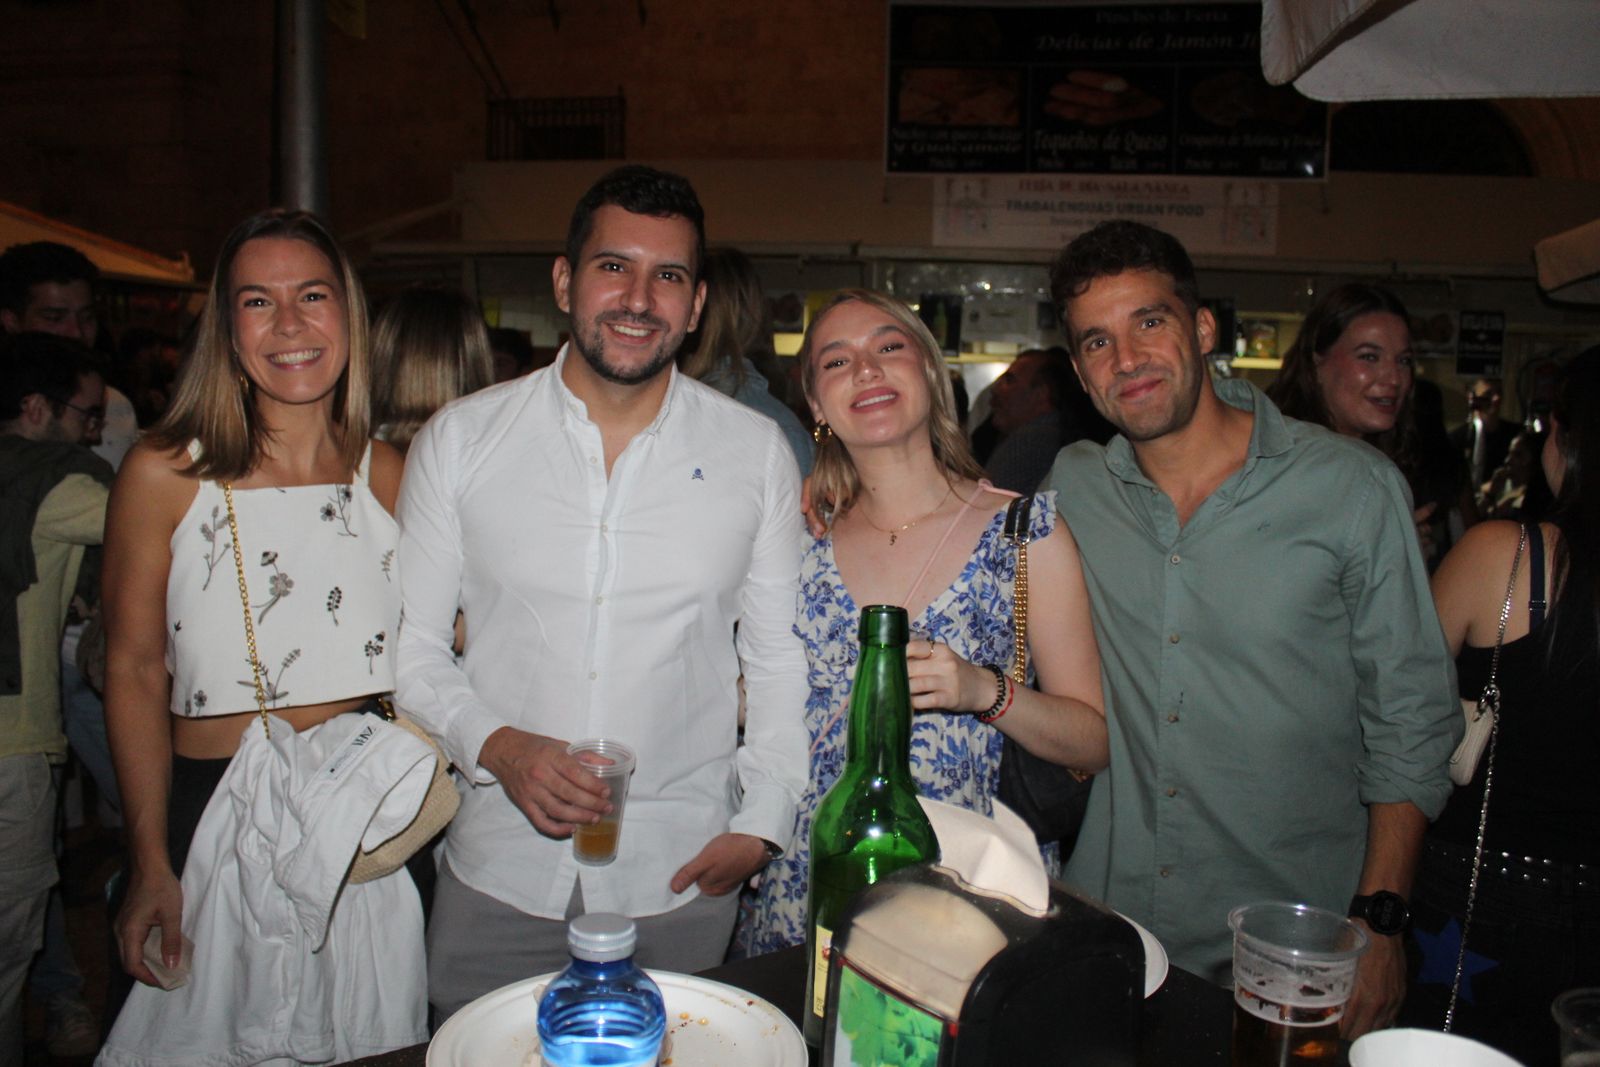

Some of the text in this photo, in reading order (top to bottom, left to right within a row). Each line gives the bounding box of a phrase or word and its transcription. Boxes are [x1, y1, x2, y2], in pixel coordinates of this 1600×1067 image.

[1127, 31, 1155, 50] de
[1116, 202, 1165, 216] URBAN
[1167, 203, 1205, 218] FOOD
